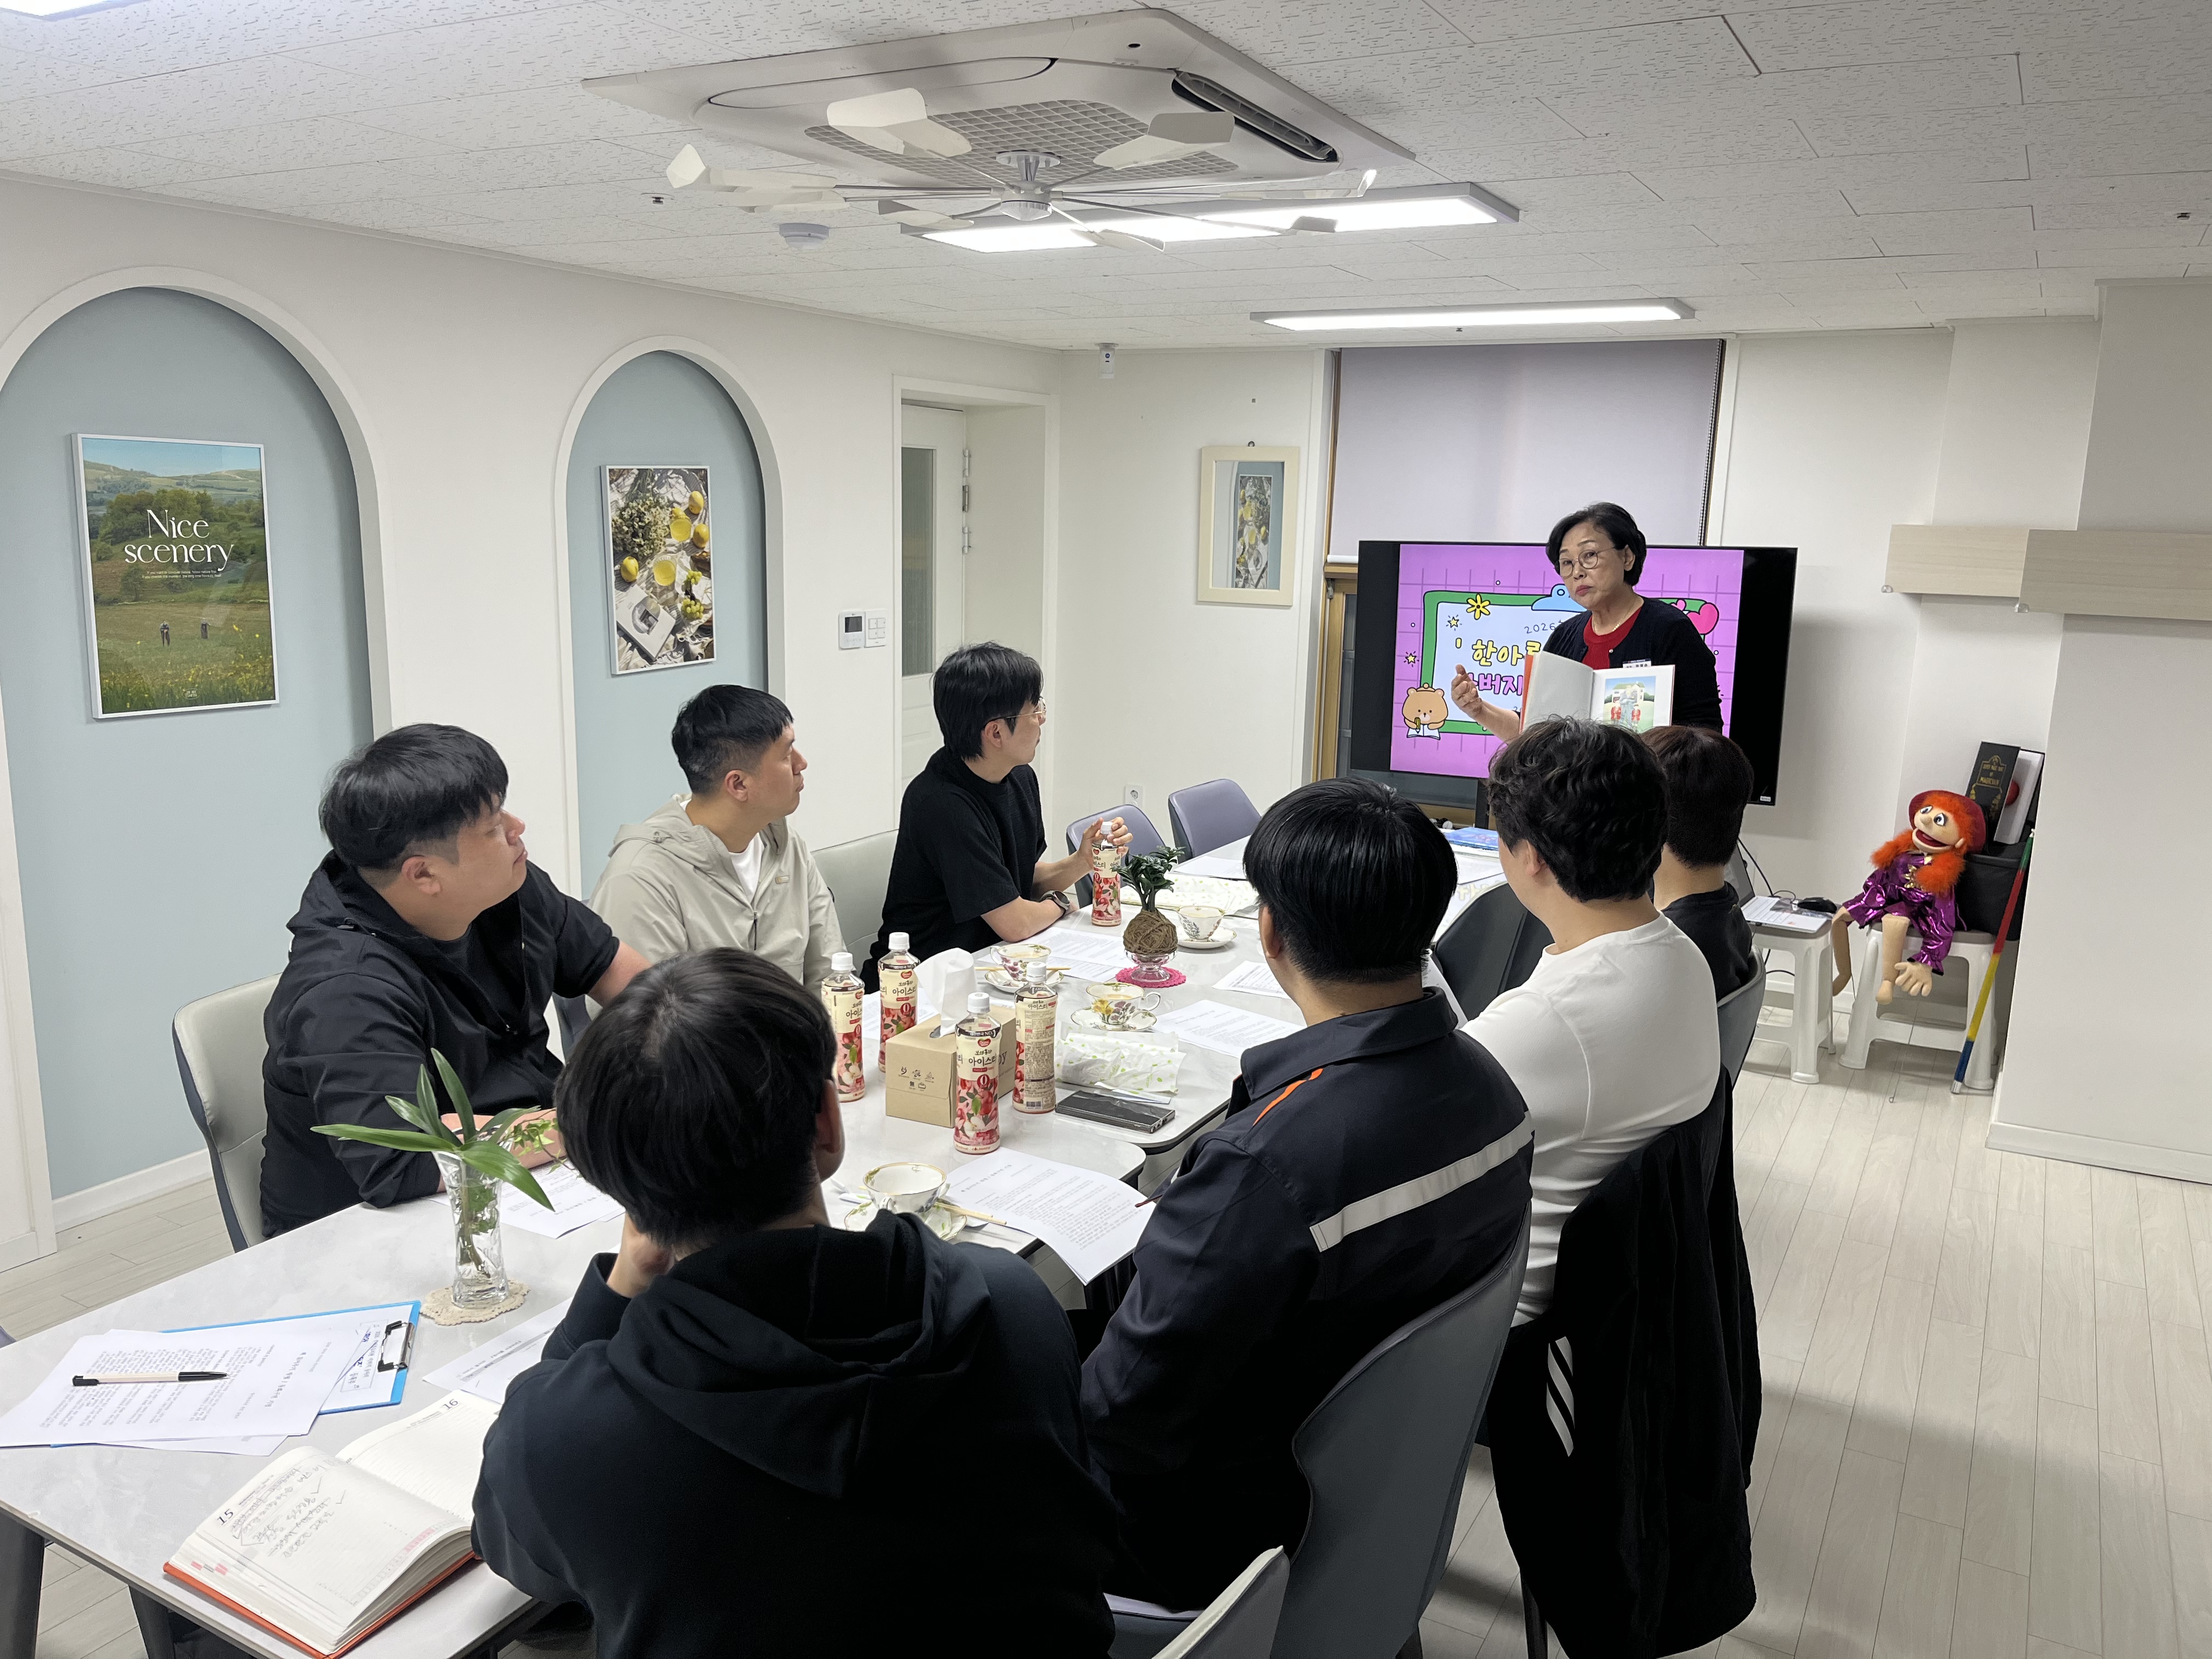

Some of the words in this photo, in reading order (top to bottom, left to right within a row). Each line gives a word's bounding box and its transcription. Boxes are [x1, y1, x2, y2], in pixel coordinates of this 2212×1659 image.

[146, 509, 210, 539] Nice
[124, 543, 234, 572] scenery
[1524, 619, 1562, 634] 2026
[968, 1053, 997, 1066] 아이스티
[443, 1398, 459, 1410] 16
[217, 1509, 234, 1526] 15
